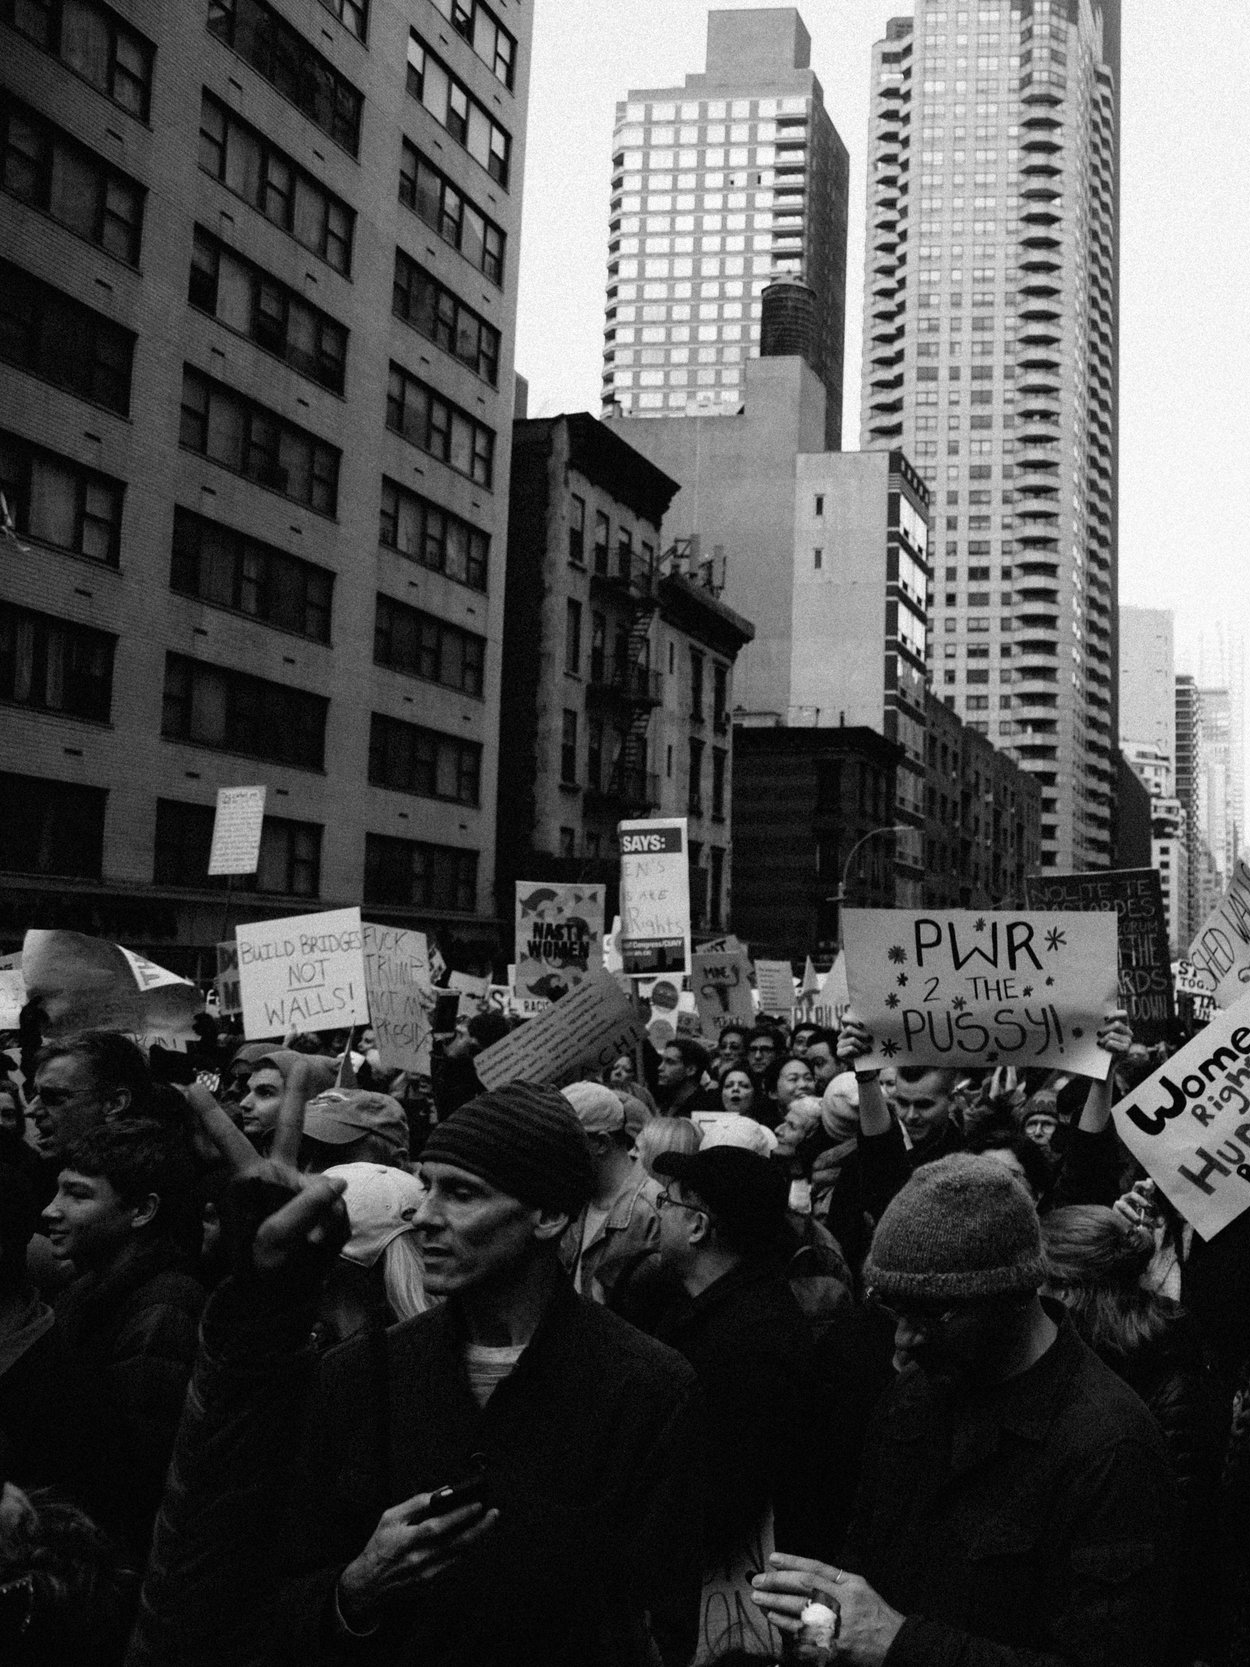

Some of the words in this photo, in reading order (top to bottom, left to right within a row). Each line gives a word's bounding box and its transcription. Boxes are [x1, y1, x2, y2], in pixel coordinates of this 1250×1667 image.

[623, 834, 666, 852] SAYS:
[1031, 883, 1112, 902] NOLITE
[1119, 879, 1151, 897] TE
[240, 941, 295, 965] BUILD
[526, 941, 590, 960] WOMEN
[914, 918, 1043, 970] PWR
[288, 959, 331, 986] NOT
[1191, 928, 1235, 992] SHED
[923, 976, 941, 1002] 2
[965, 976, 1019, 1001] THE
[264, 983, 355, 1026] WALLS!
[902, 1004, 1064, 1055] PUSSY!
